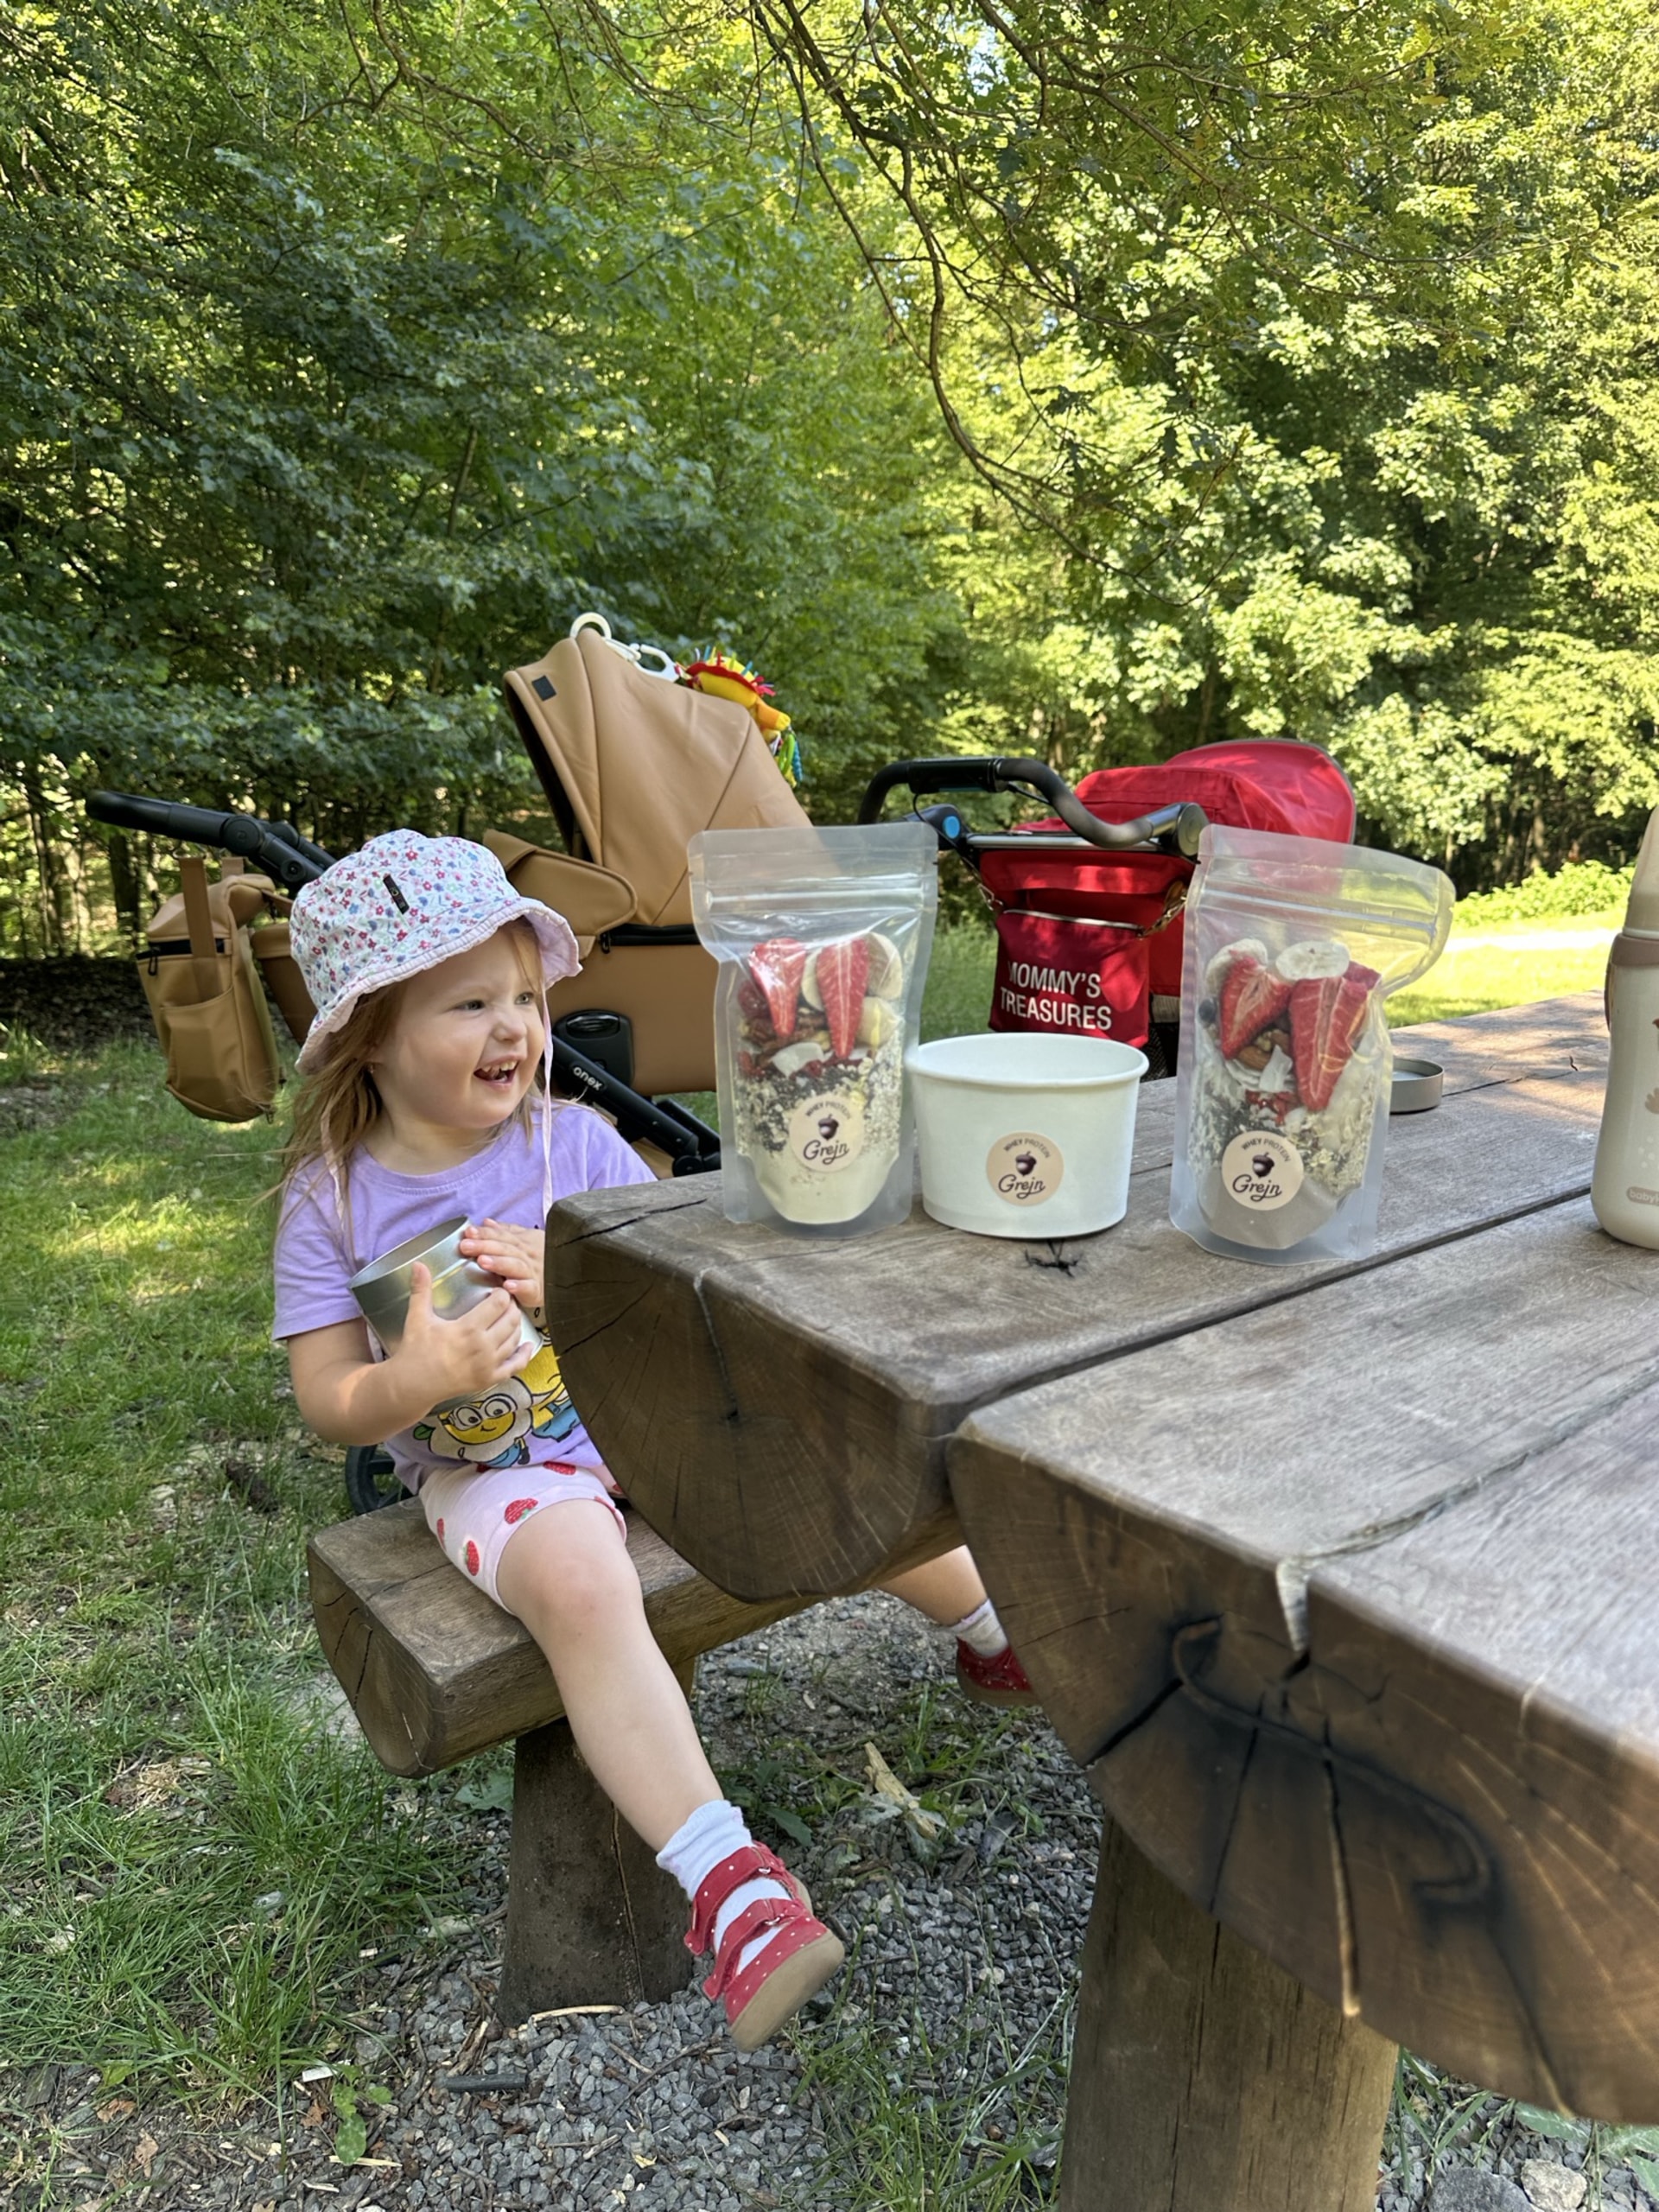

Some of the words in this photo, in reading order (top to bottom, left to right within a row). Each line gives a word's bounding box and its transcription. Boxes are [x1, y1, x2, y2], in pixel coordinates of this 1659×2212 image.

[1007, 961, 1102, 999] MOMMY'S
[1000, 986, 1113, 1031] TREASURES
[573, 1066, 603, 1090] onex
[803, 1140, 850, 1165] Grejn
[1242, 1138, 1262, 1150] WHEY
[1263, 1138, 1291, 1162] PROTEIN
[998, 1173, 1046, 1200] Grejn
[1232, 1173, 1282, 1202] Grejn
